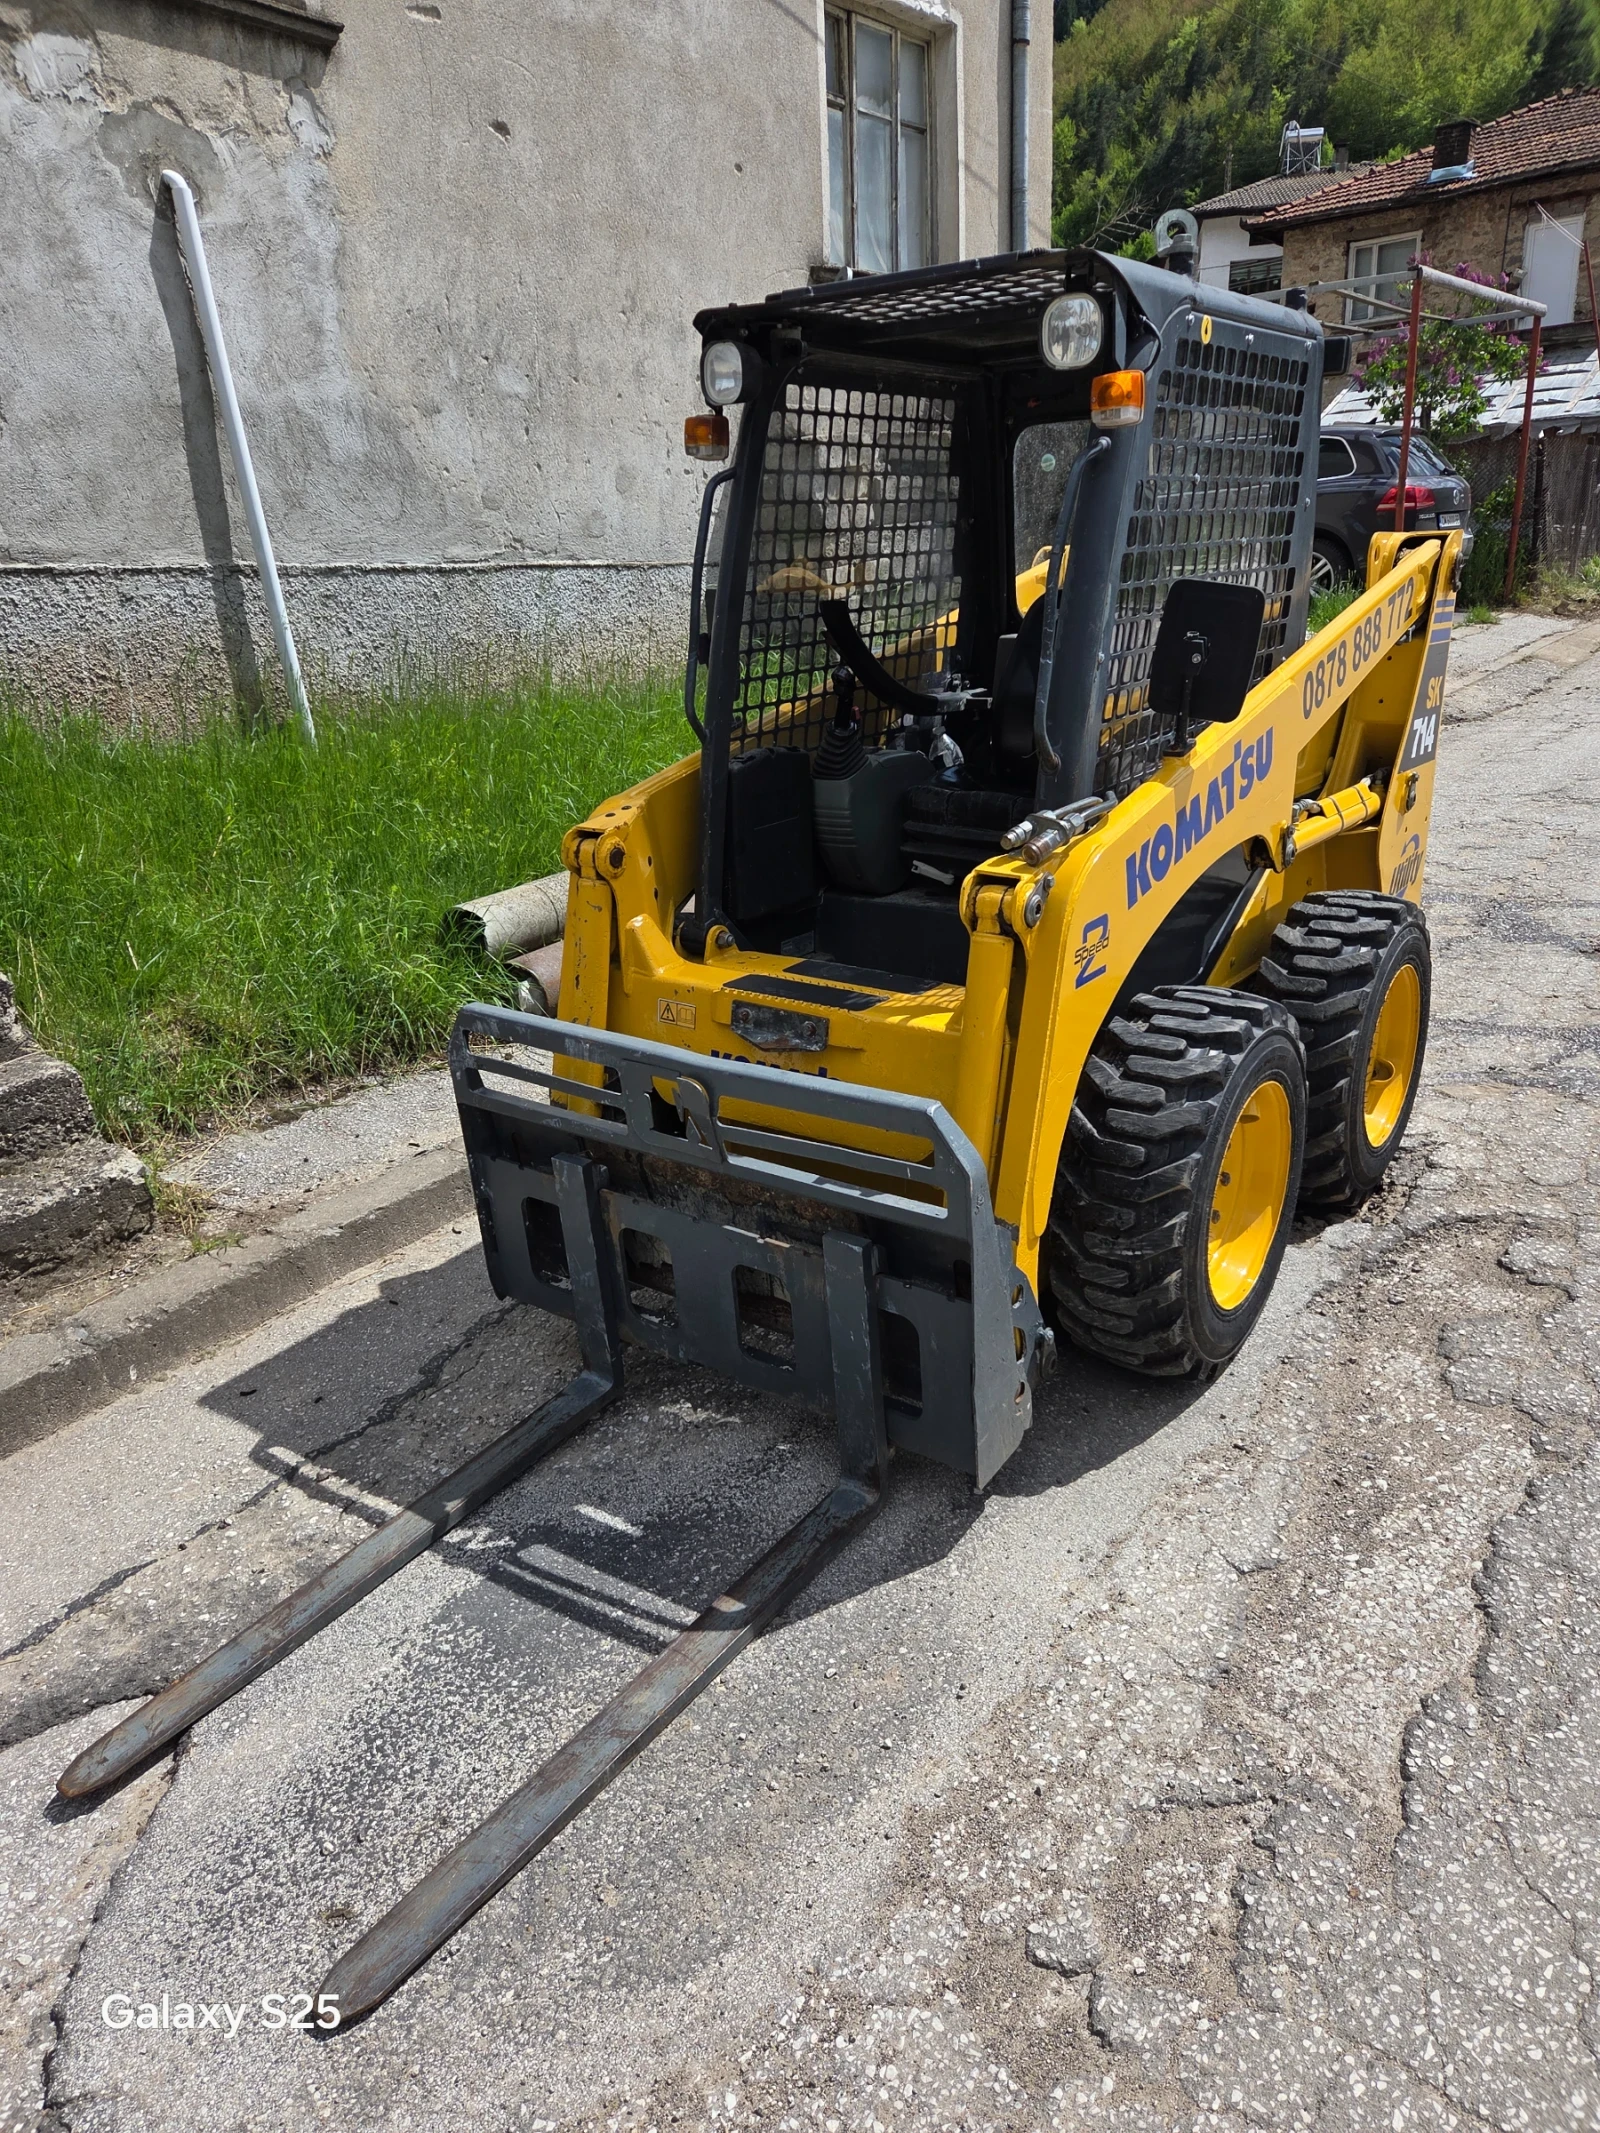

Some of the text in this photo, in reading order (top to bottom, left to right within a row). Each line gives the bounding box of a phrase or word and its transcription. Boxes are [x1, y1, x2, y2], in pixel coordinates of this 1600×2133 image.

[1303, 577, 1415, 719] 0878 888 772
[1426, 675, 1443, 709] SK
[1411, 714, 1436, 758] 714
[1126, 726, 1273, 910] KOMATSU
